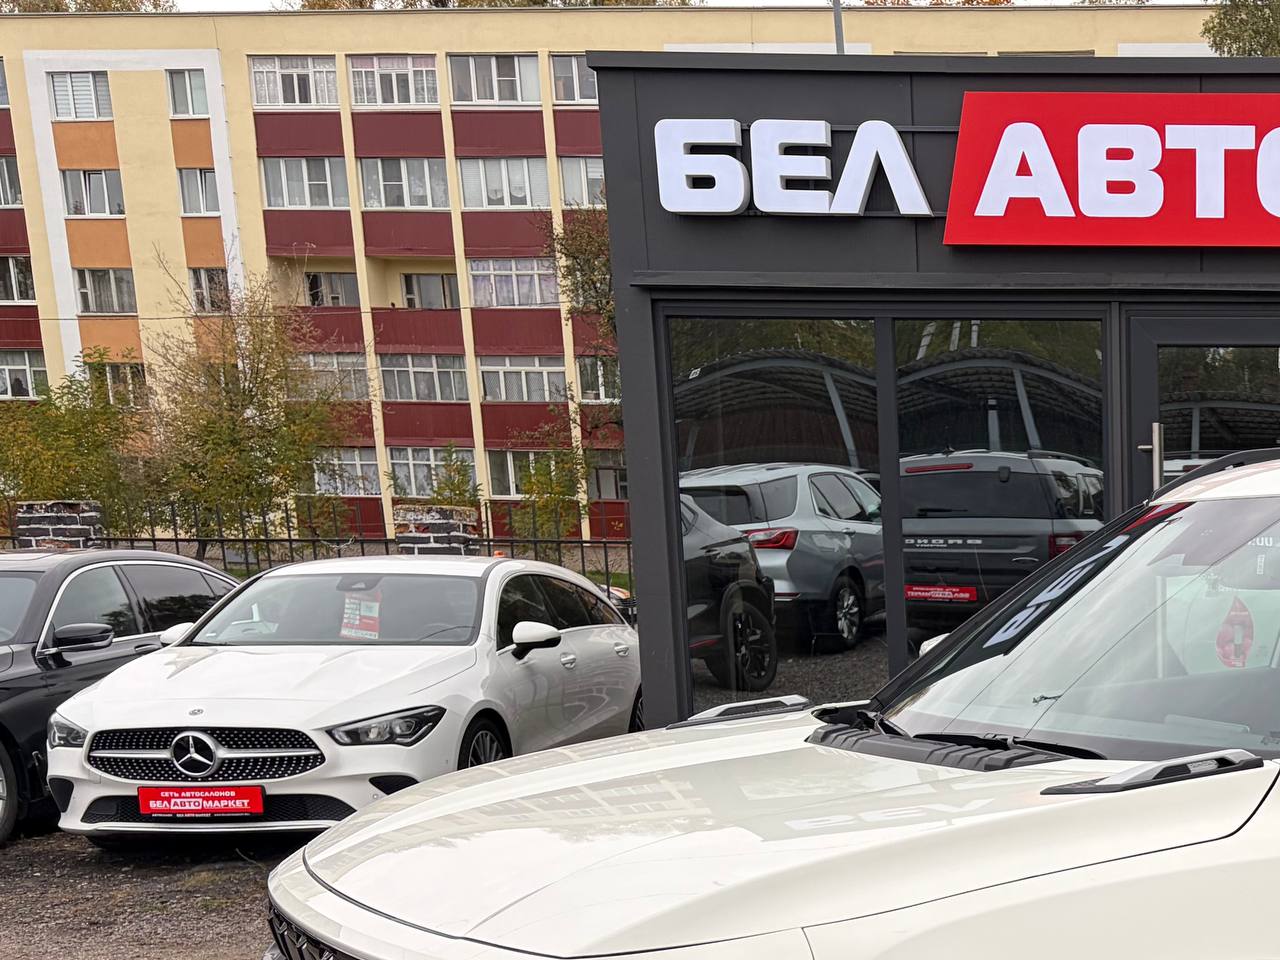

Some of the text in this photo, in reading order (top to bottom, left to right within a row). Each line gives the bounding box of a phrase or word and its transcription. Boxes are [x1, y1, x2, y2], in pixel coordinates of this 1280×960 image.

[654, 118, 935, 217] БЕЛ
[149, 799, 250, 809] БЕЛ АВТО МАРКЕТ
